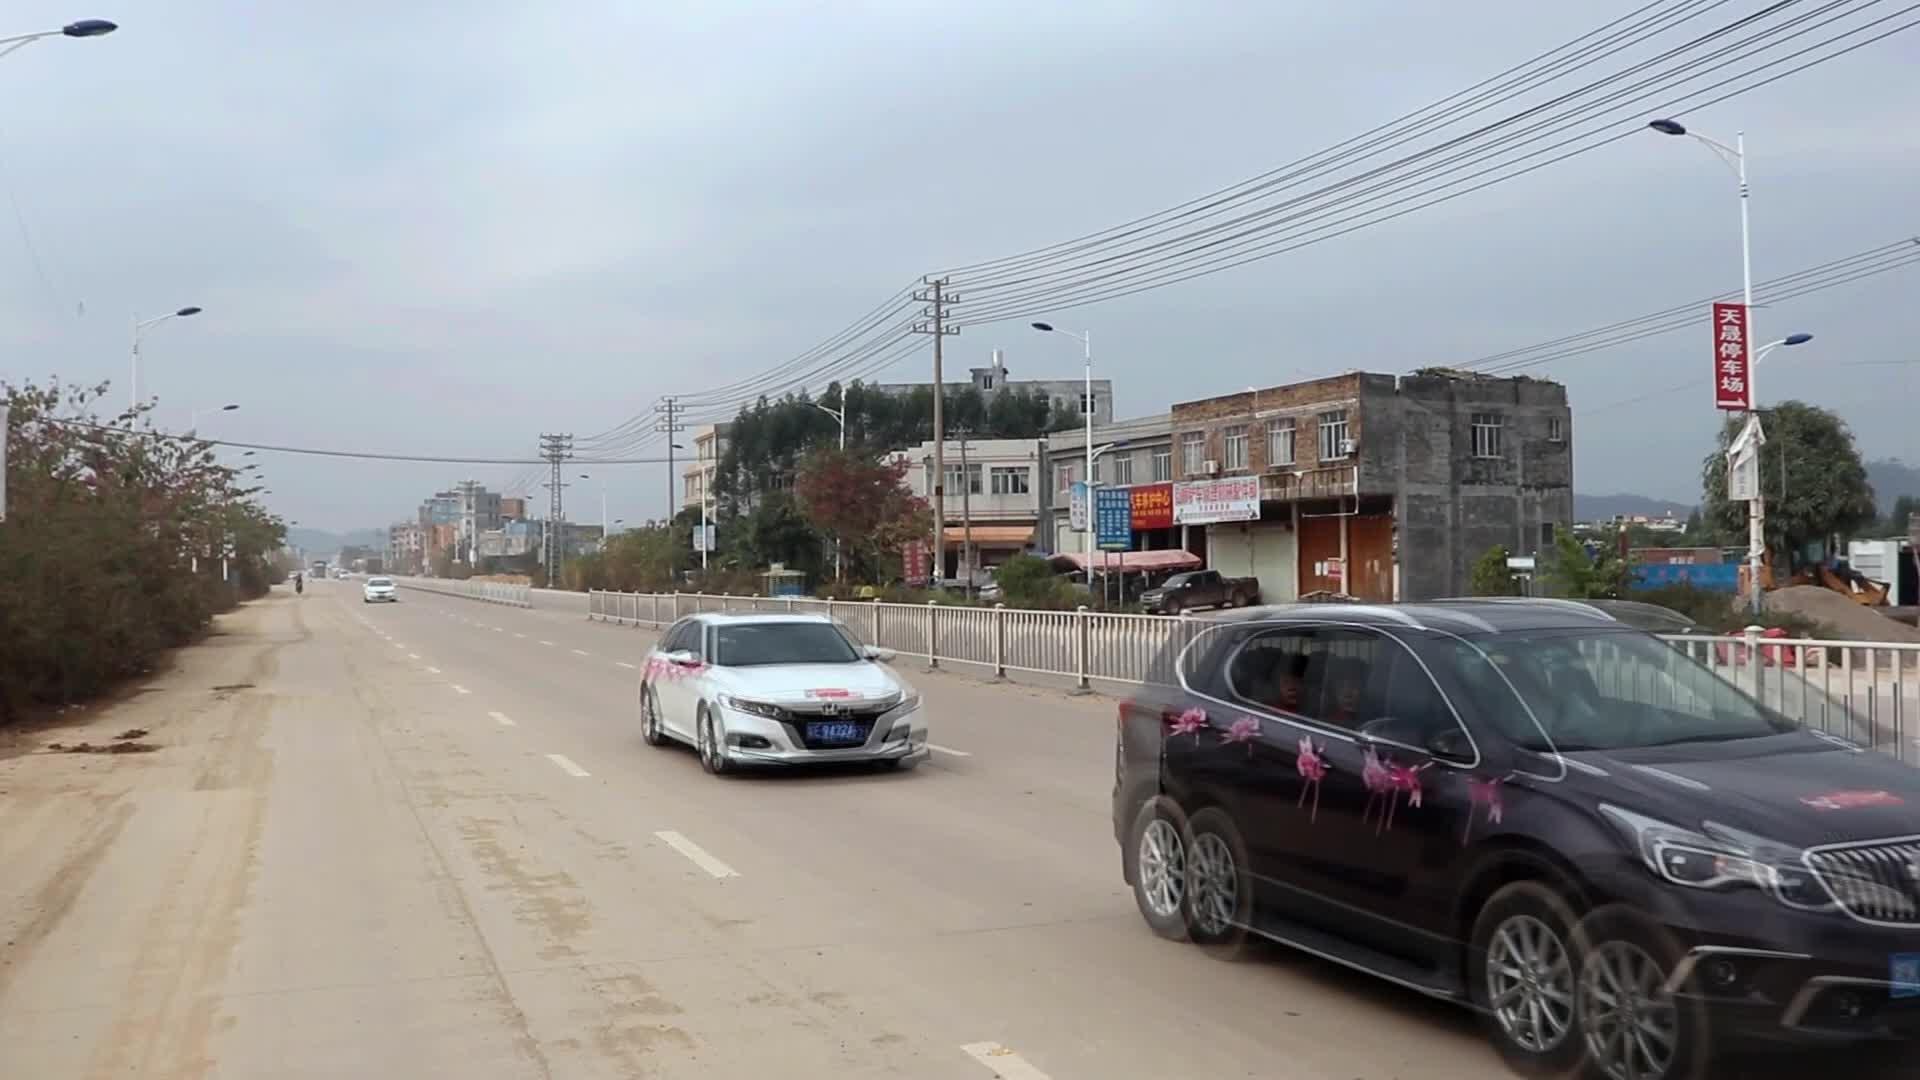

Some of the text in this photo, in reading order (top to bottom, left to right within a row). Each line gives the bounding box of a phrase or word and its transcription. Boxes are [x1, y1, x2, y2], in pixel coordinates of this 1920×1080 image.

[1719, 308, 1744, 393] 天晟停车场
